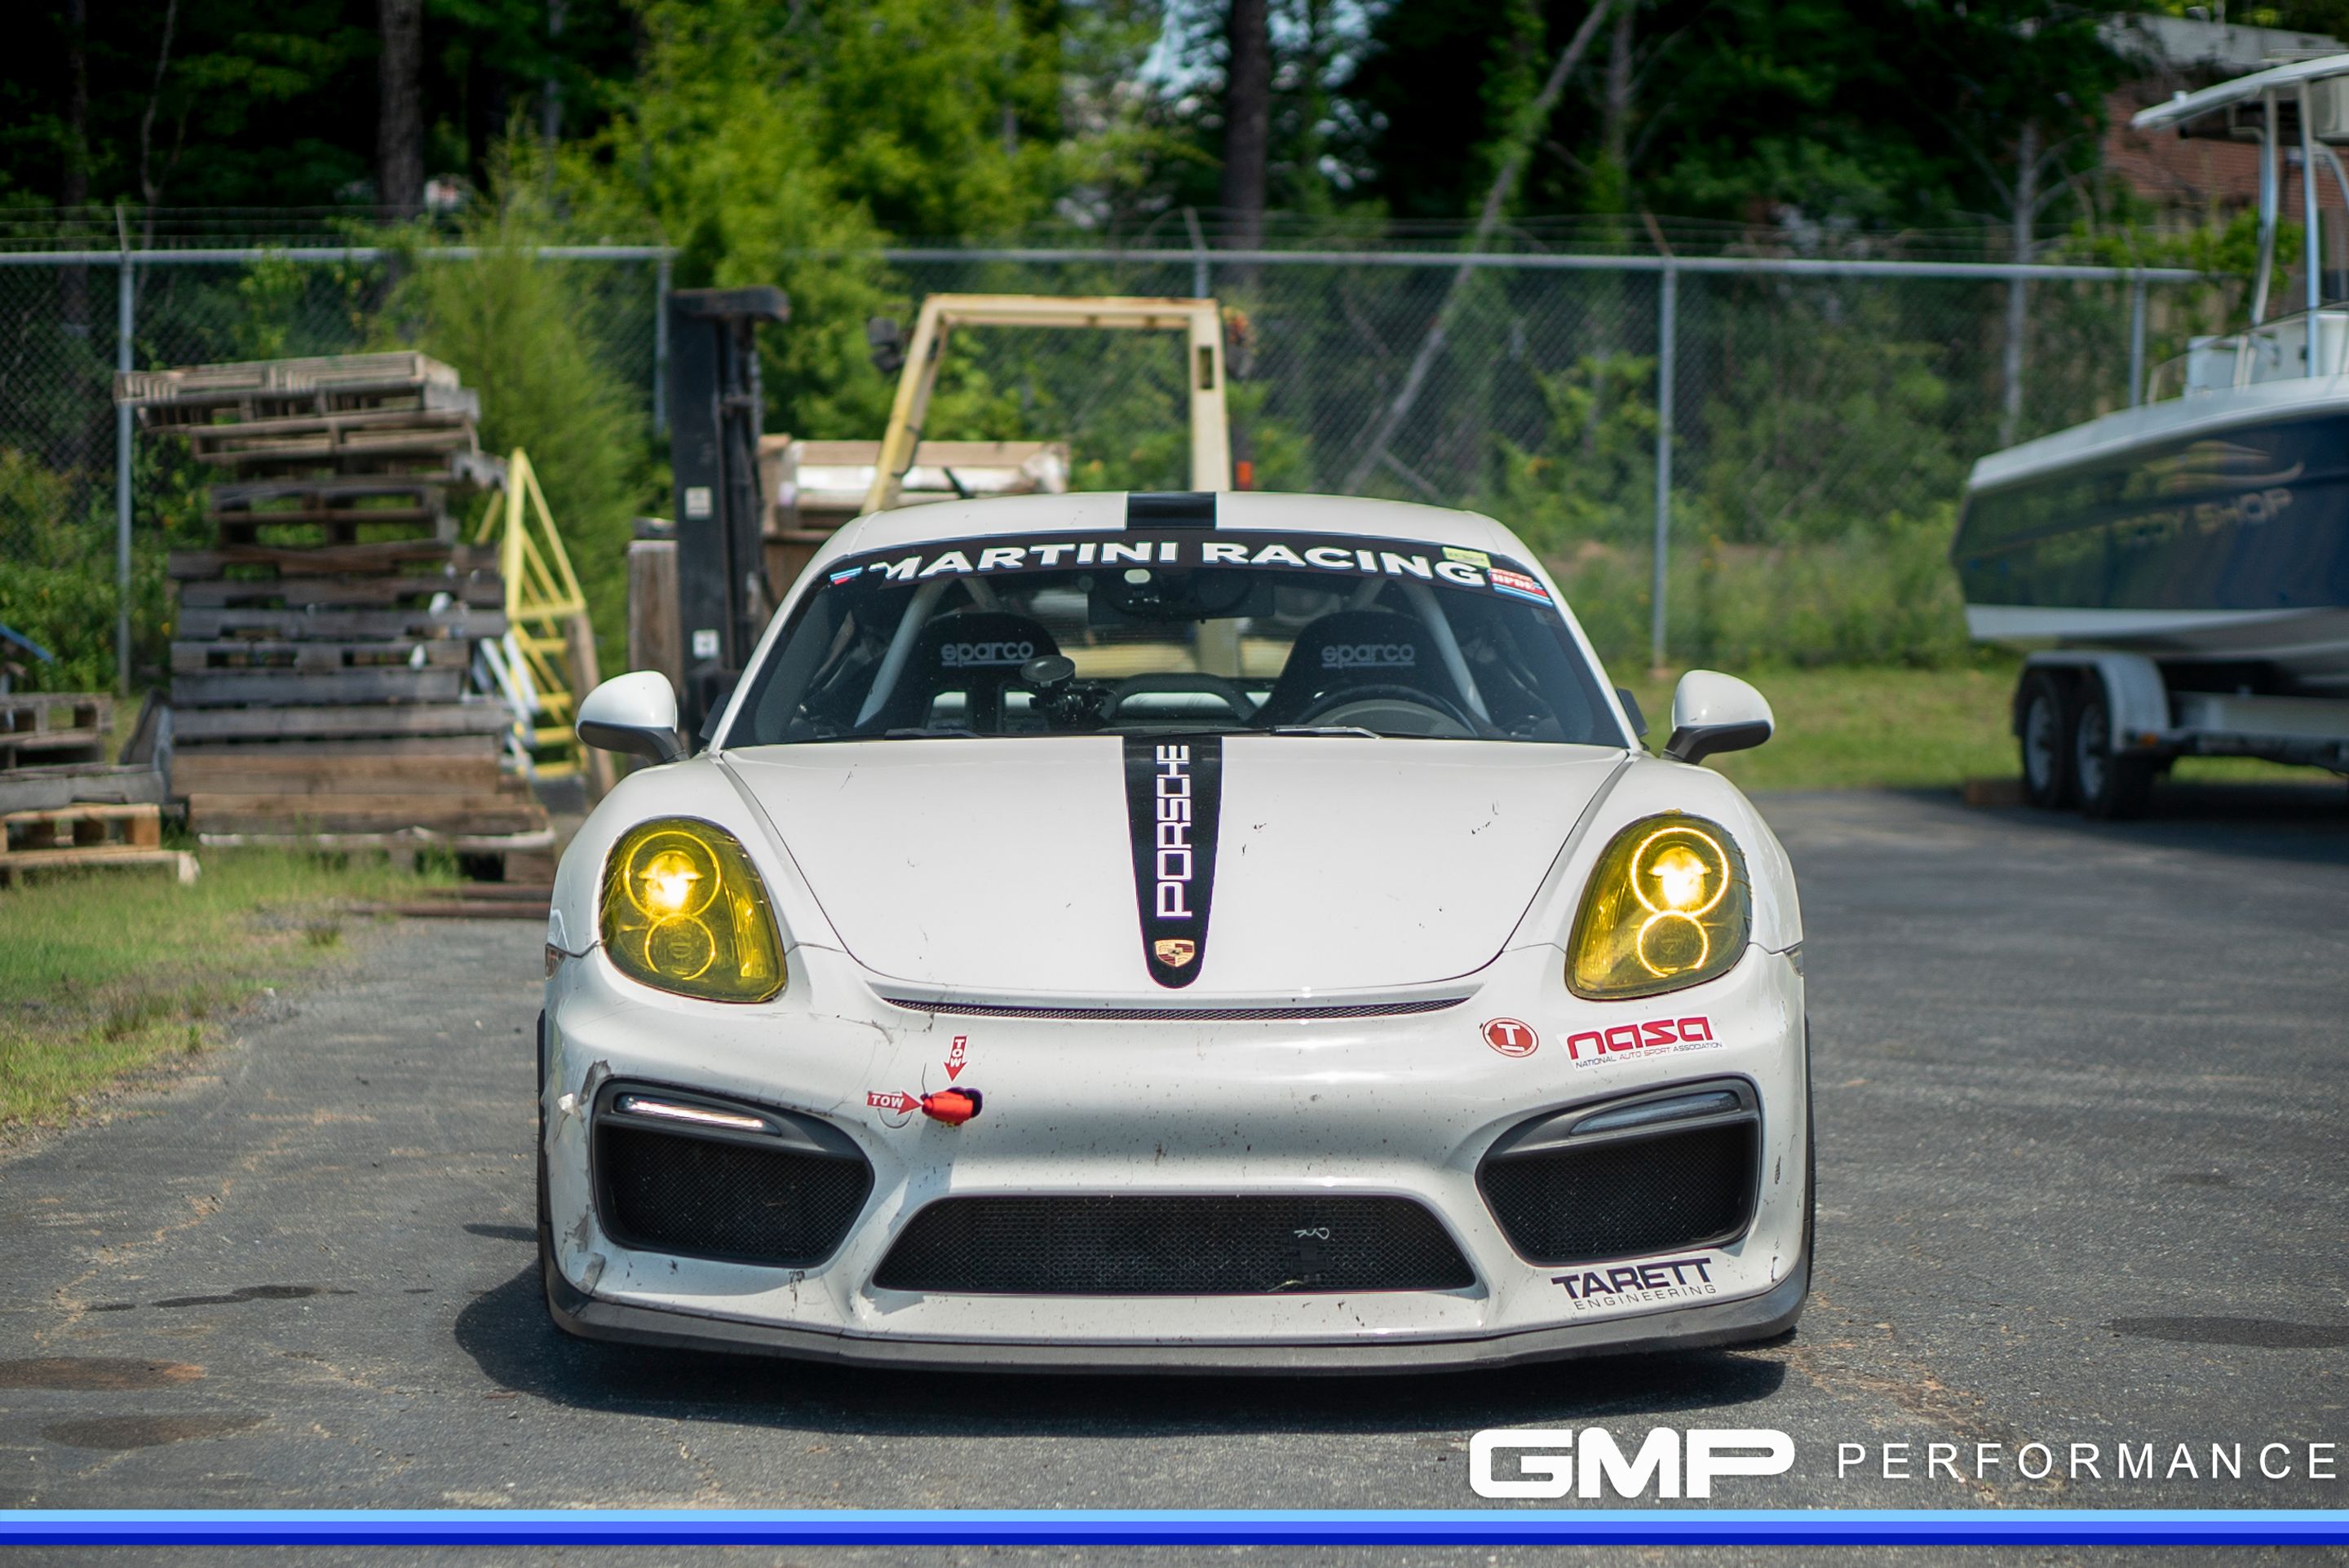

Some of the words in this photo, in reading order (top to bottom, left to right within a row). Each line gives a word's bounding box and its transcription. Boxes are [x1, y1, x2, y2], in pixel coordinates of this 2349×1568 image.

[869, 542, 1178, 581] MARTINI
[1202, 542, 1486, 586] RACING
[940, 641, 1033, 667] sparco
[1321, 643, 1415, 669] sparco
[1157, 745, 1192, 917] PORSCHE
[1567, 1017, 1714, 1060] nasa
[950, 1039, 965, 1067] TOW
[1575, 1055, 1617, 1069] NATIONAL
[1619, 1050, 1641, 1061] AUTO
[1643, 1047, 1671, 1057] SPORT
[1673, 1041, 1723, 1053] ASSOCIATION
[871, 1094, 905, 1108] TOW
[1551, 1257, 1711, 1300] TARETT
[1573, 1284, 1717, 1310] ENGINEERING
